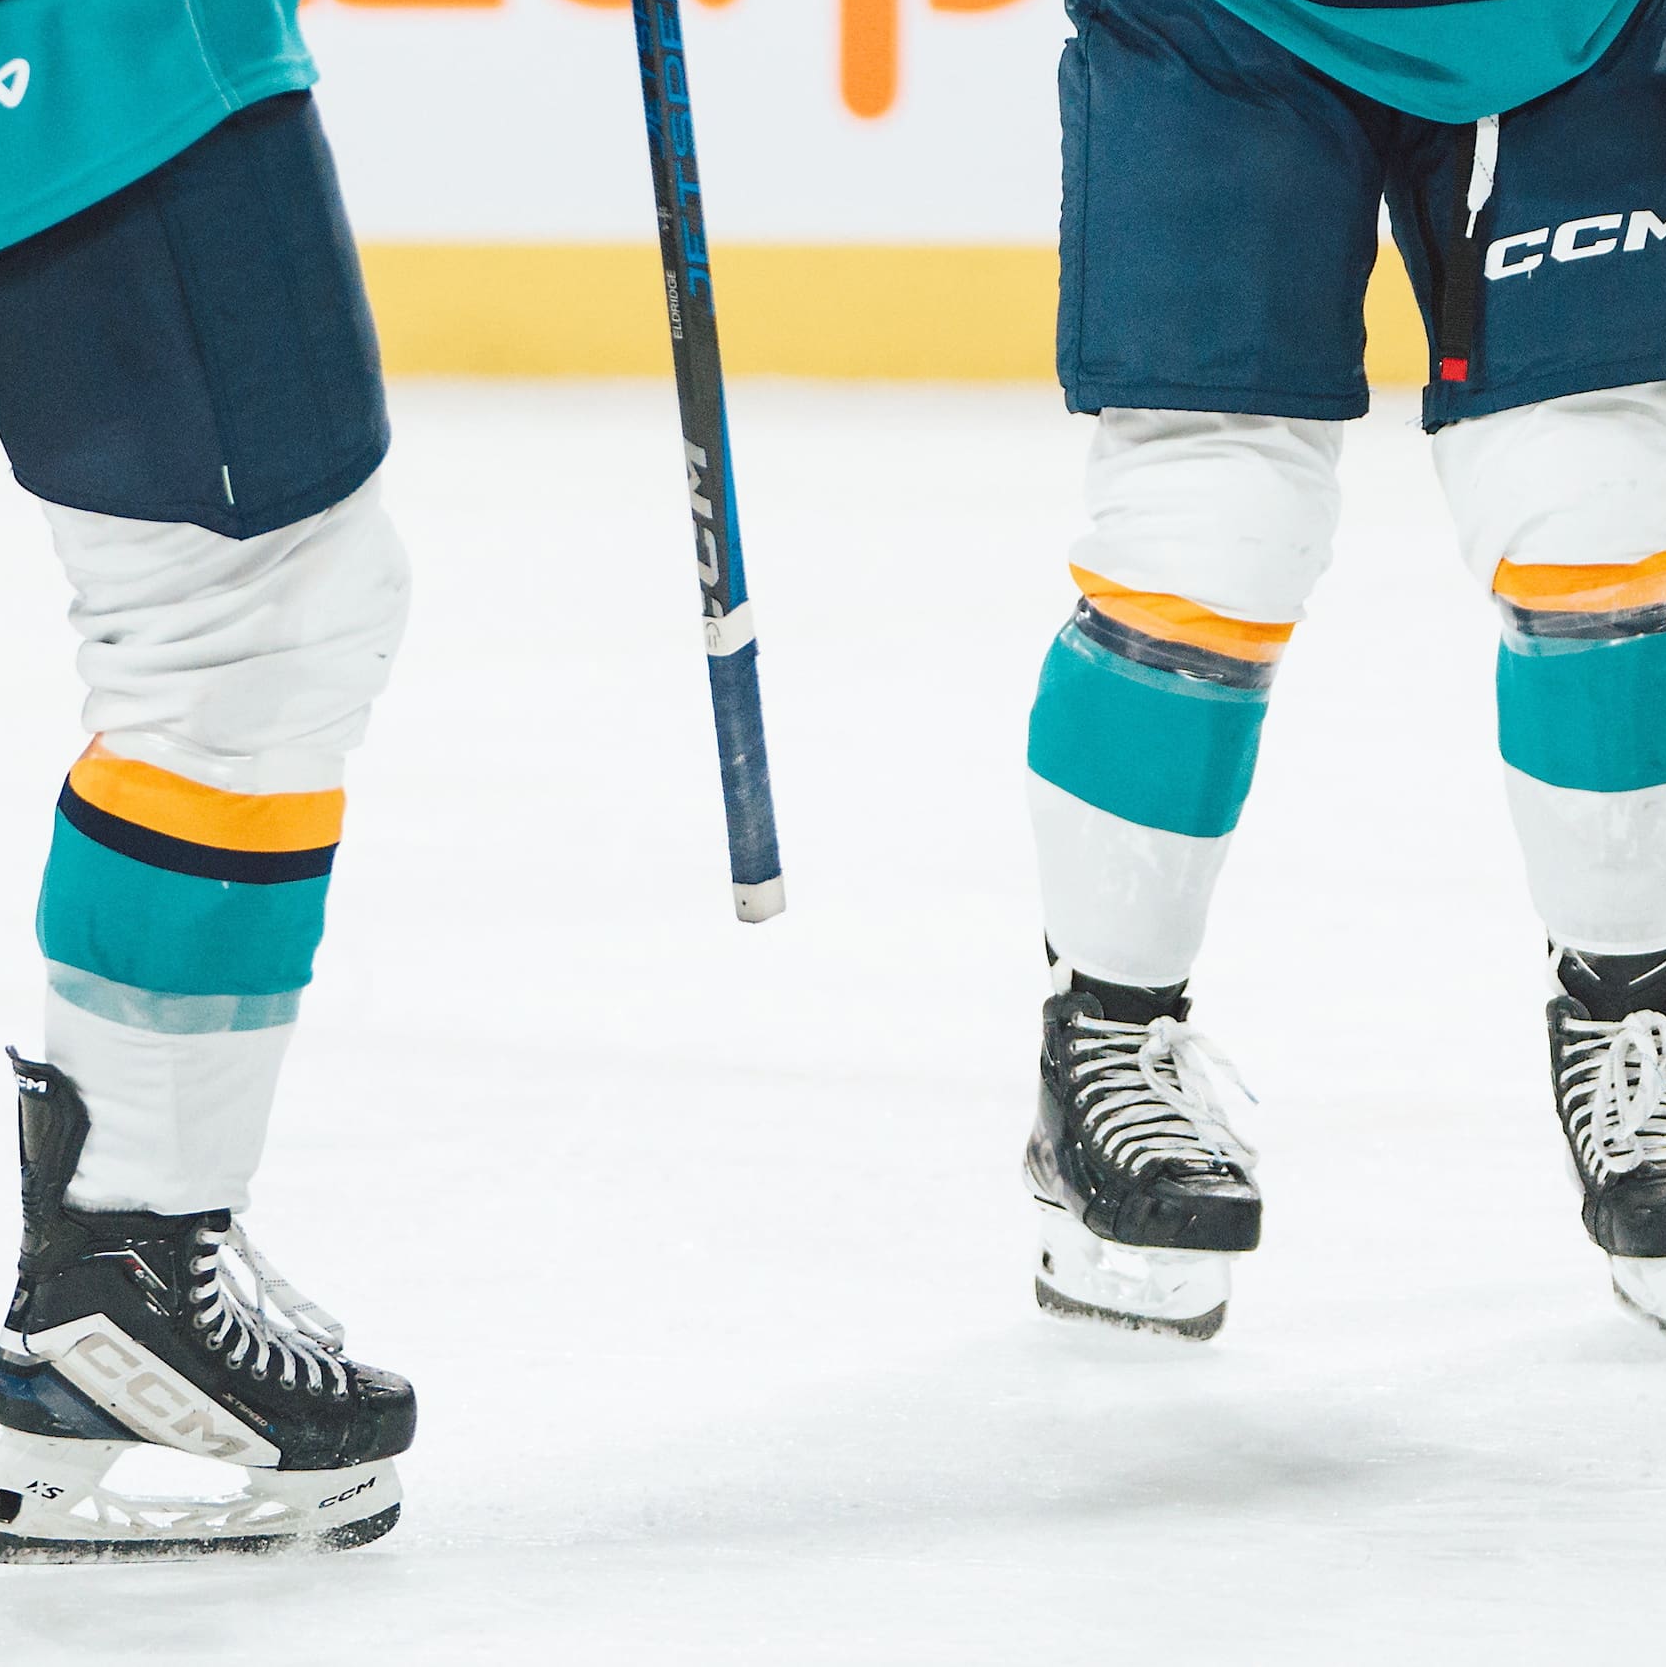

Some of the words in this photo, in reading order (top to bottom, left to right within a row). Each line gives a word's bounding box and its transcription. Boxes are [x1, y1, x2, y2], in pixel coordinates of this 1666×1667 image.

[665, 269, 683, 340] ELDRIDGE
[76, 1334, 251, 1459] CCM
[318, 1476, 378, 1510] CCM
